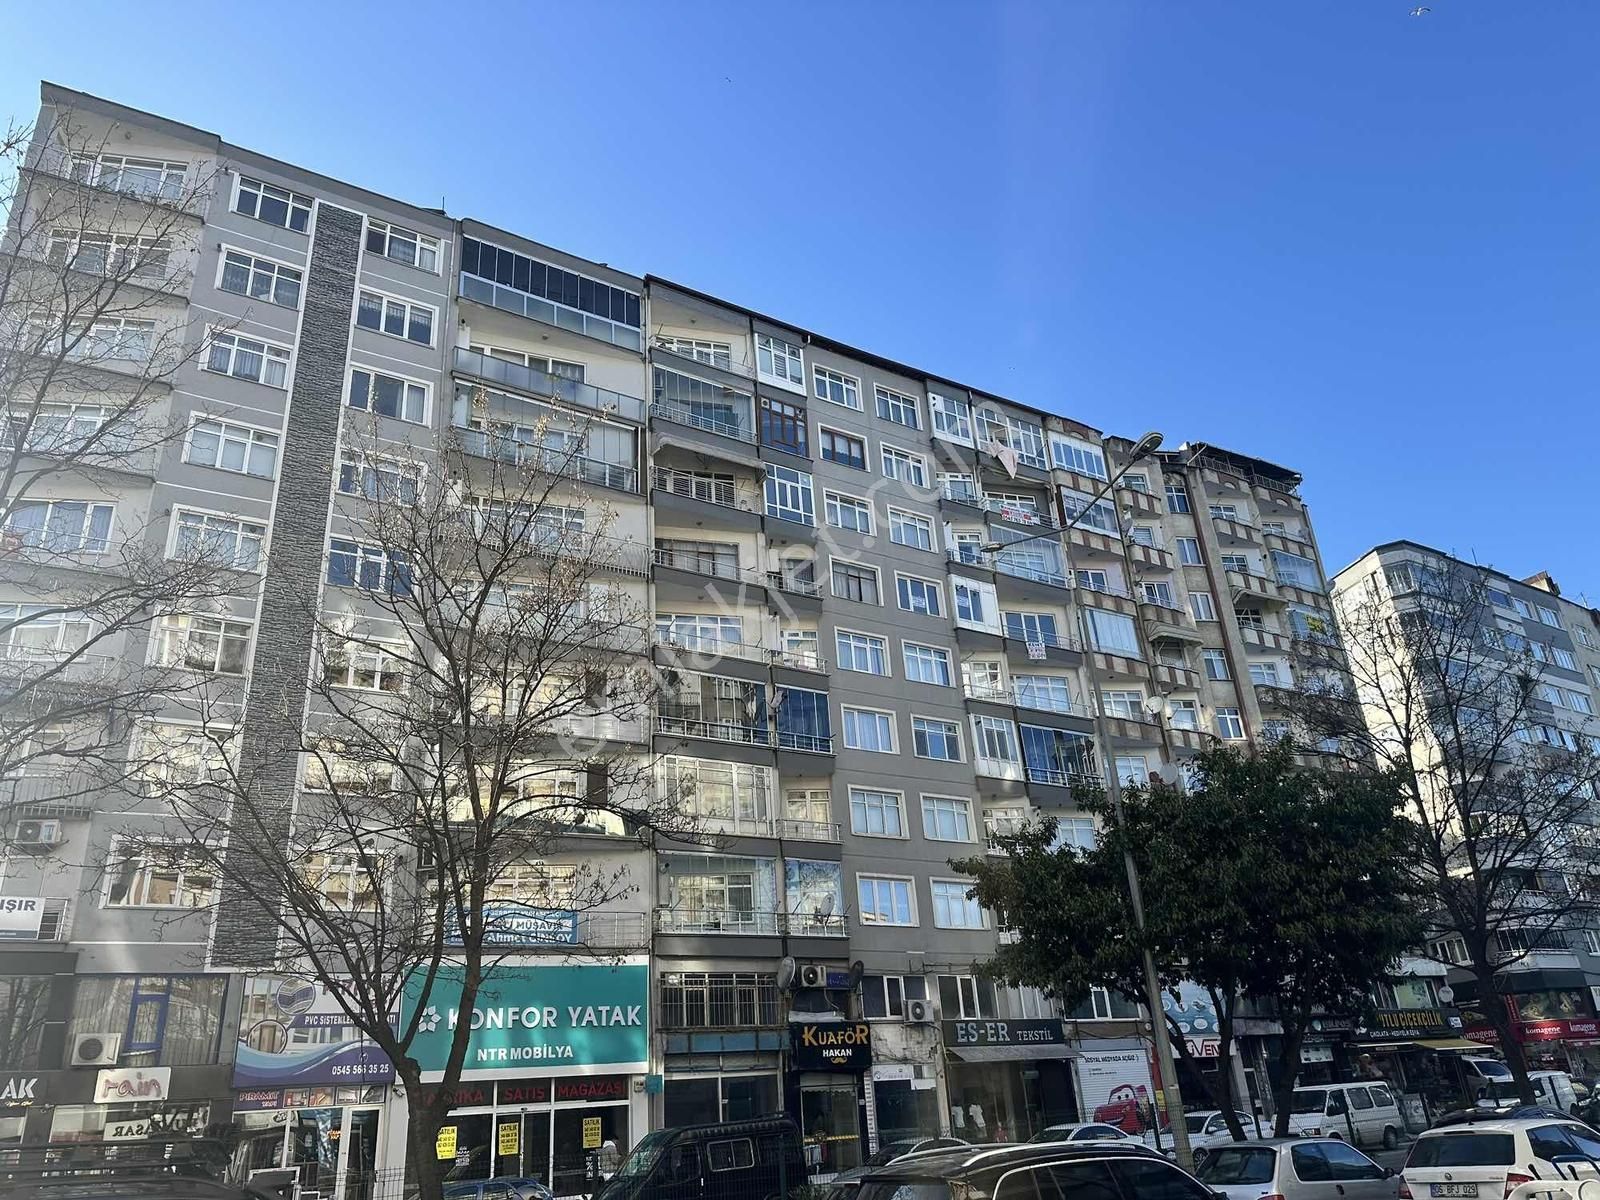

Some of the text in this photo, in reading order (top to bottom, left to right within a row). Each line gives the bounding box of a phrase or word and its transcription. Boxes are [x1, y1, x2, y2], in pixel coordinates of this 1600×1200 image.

[304, 1015, 319, 1025] PVC
[447, 1005, 642, 1030] KONFOR YATAK
[802, 1024, 869, 1047] KUAFÖR
[956, 1022, 1054, 1043] ES-ER TEKSTİL
[1525, 1026, 1560, 1035] komagene
[477, 1044, 573, 1062] NTR MOBİLYA
[822, 1048, 852, 1058] HAKAN
[332, 1065, 350, 1075] 0545
[368, 1064, 378, 1074] 35
[379, 1063, 389, 1073] 25
